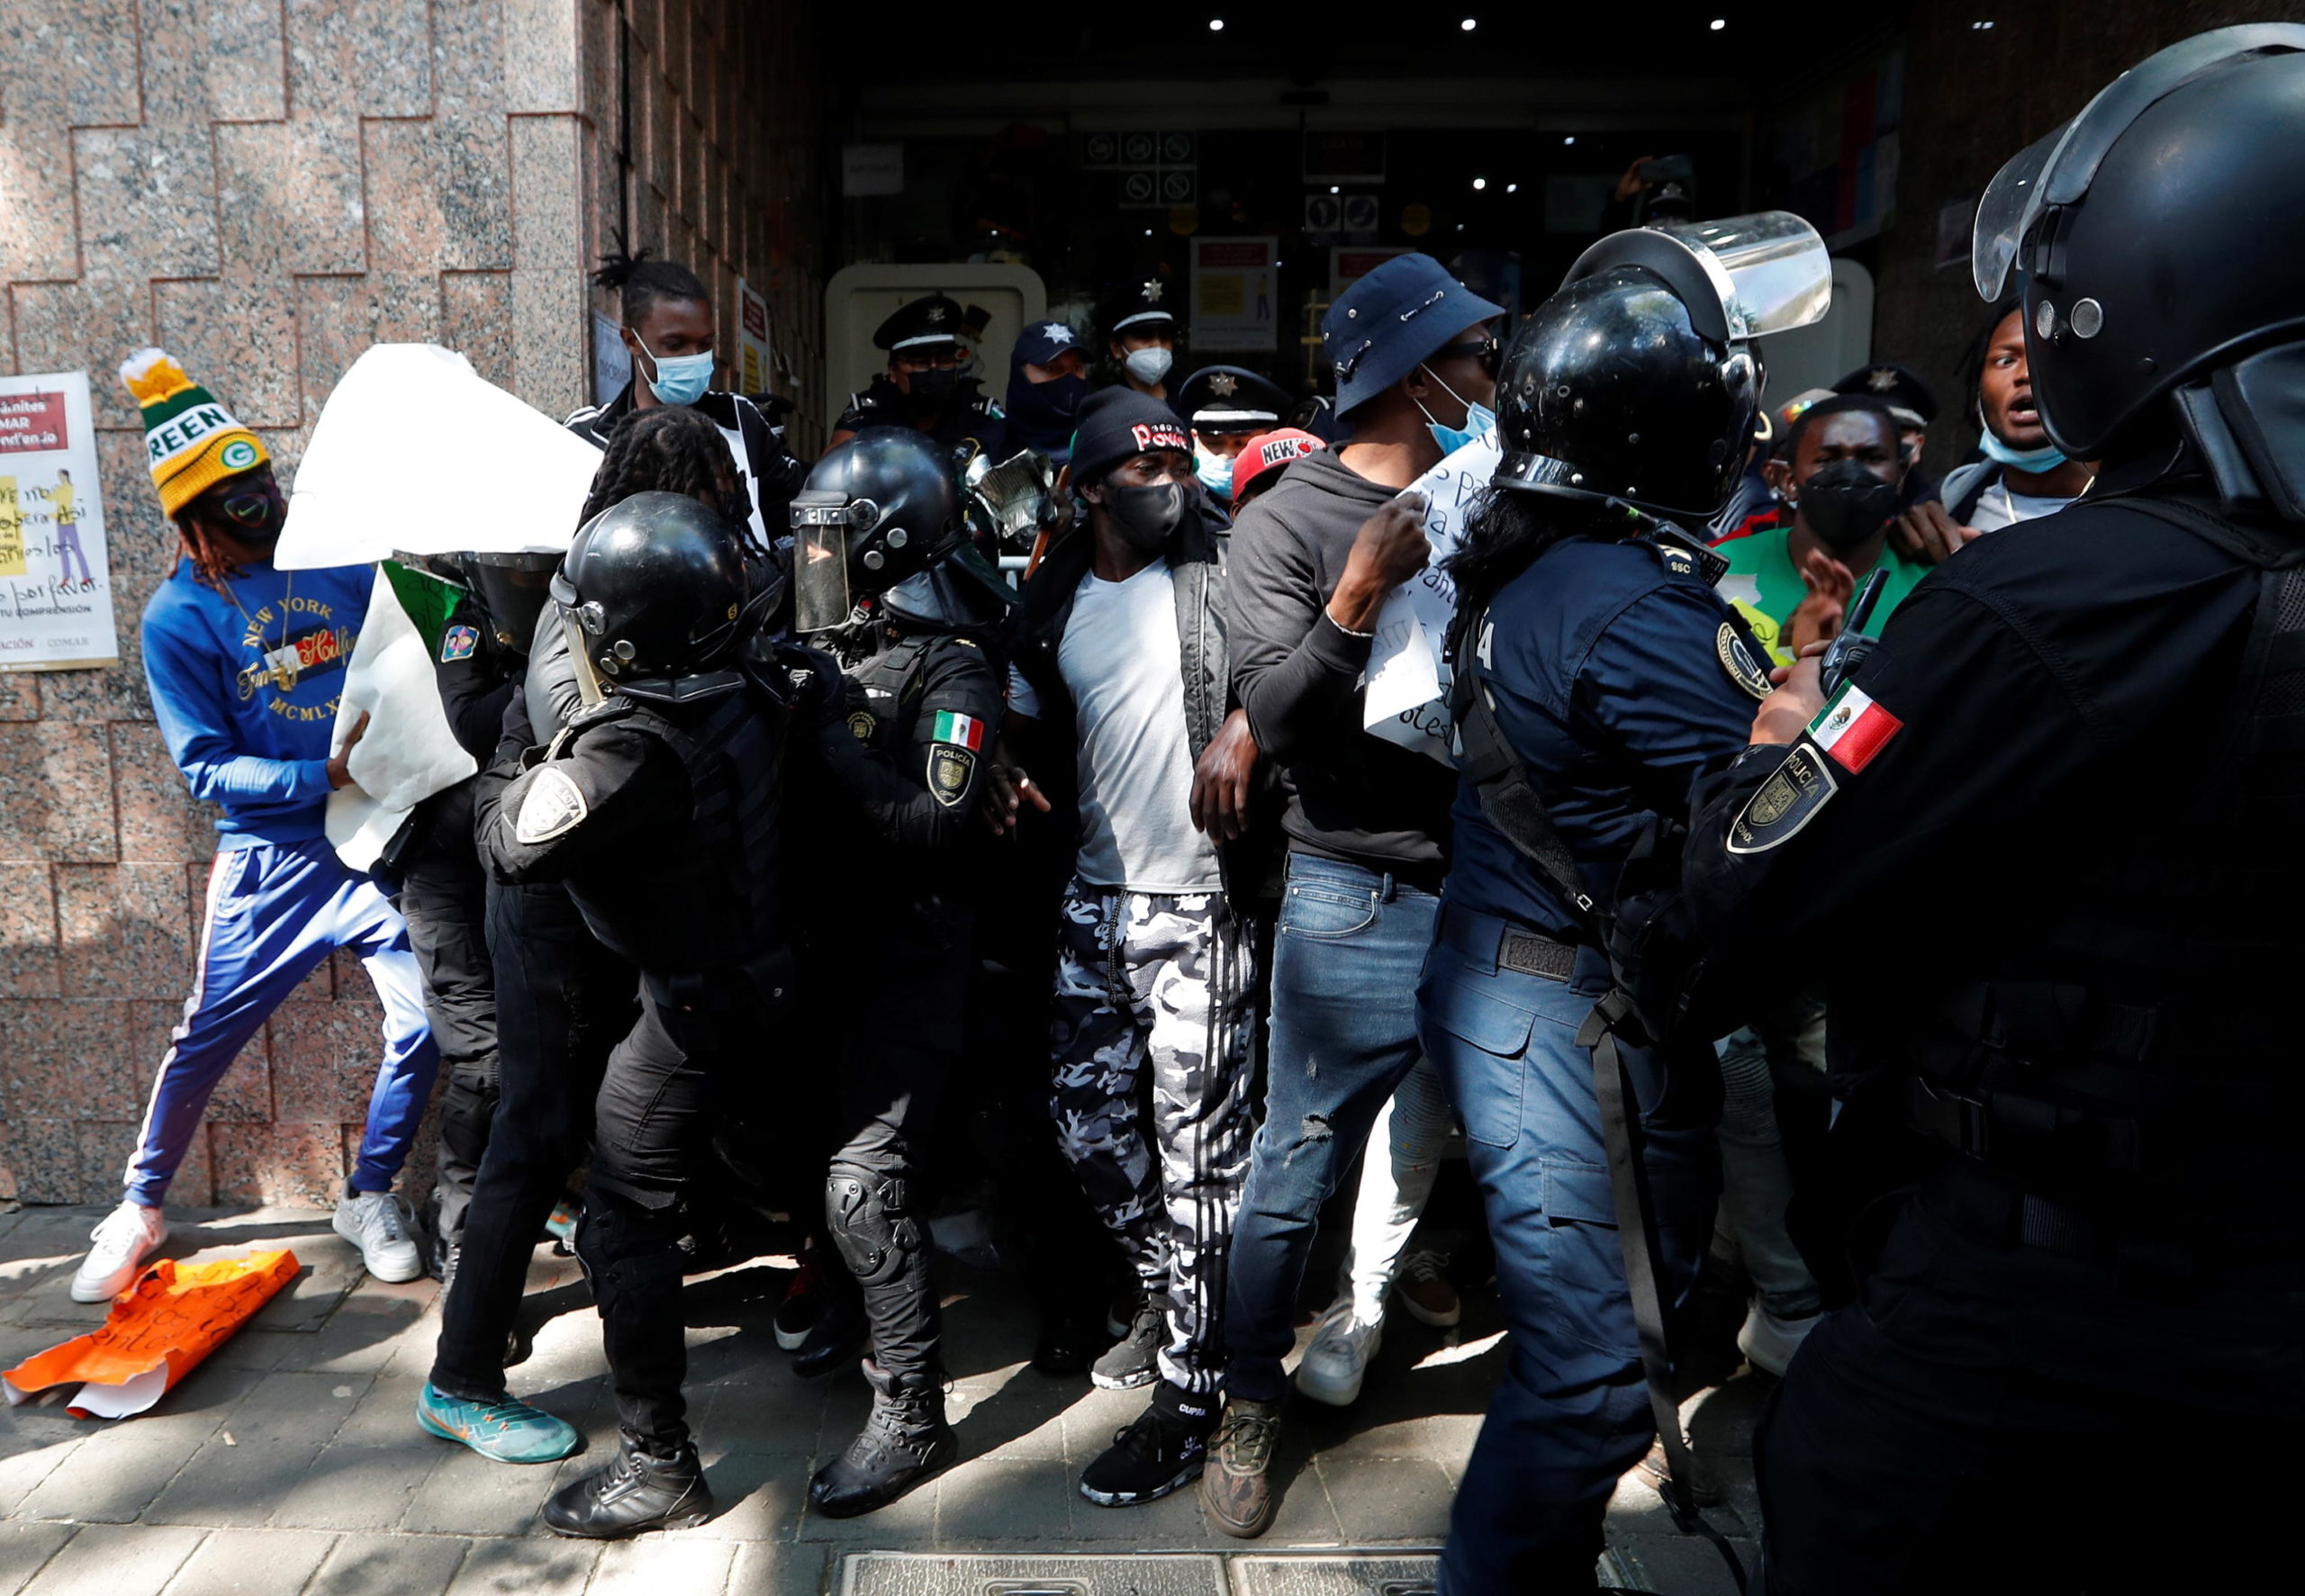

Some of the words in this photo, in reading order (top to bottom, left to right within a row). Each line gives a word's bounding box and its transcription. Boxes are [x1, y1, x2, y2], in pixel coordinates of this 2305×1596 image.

[1262, 439, 1295, 464] NEW
[242, 606, 274, 647] NEW
[277, 597, 333, 619] YORK
[47, 636, 89, 647] COMAR
[1786, 754, 1821, 799] POLICÍA
[1736, 821, 1755, 844] CDMX
